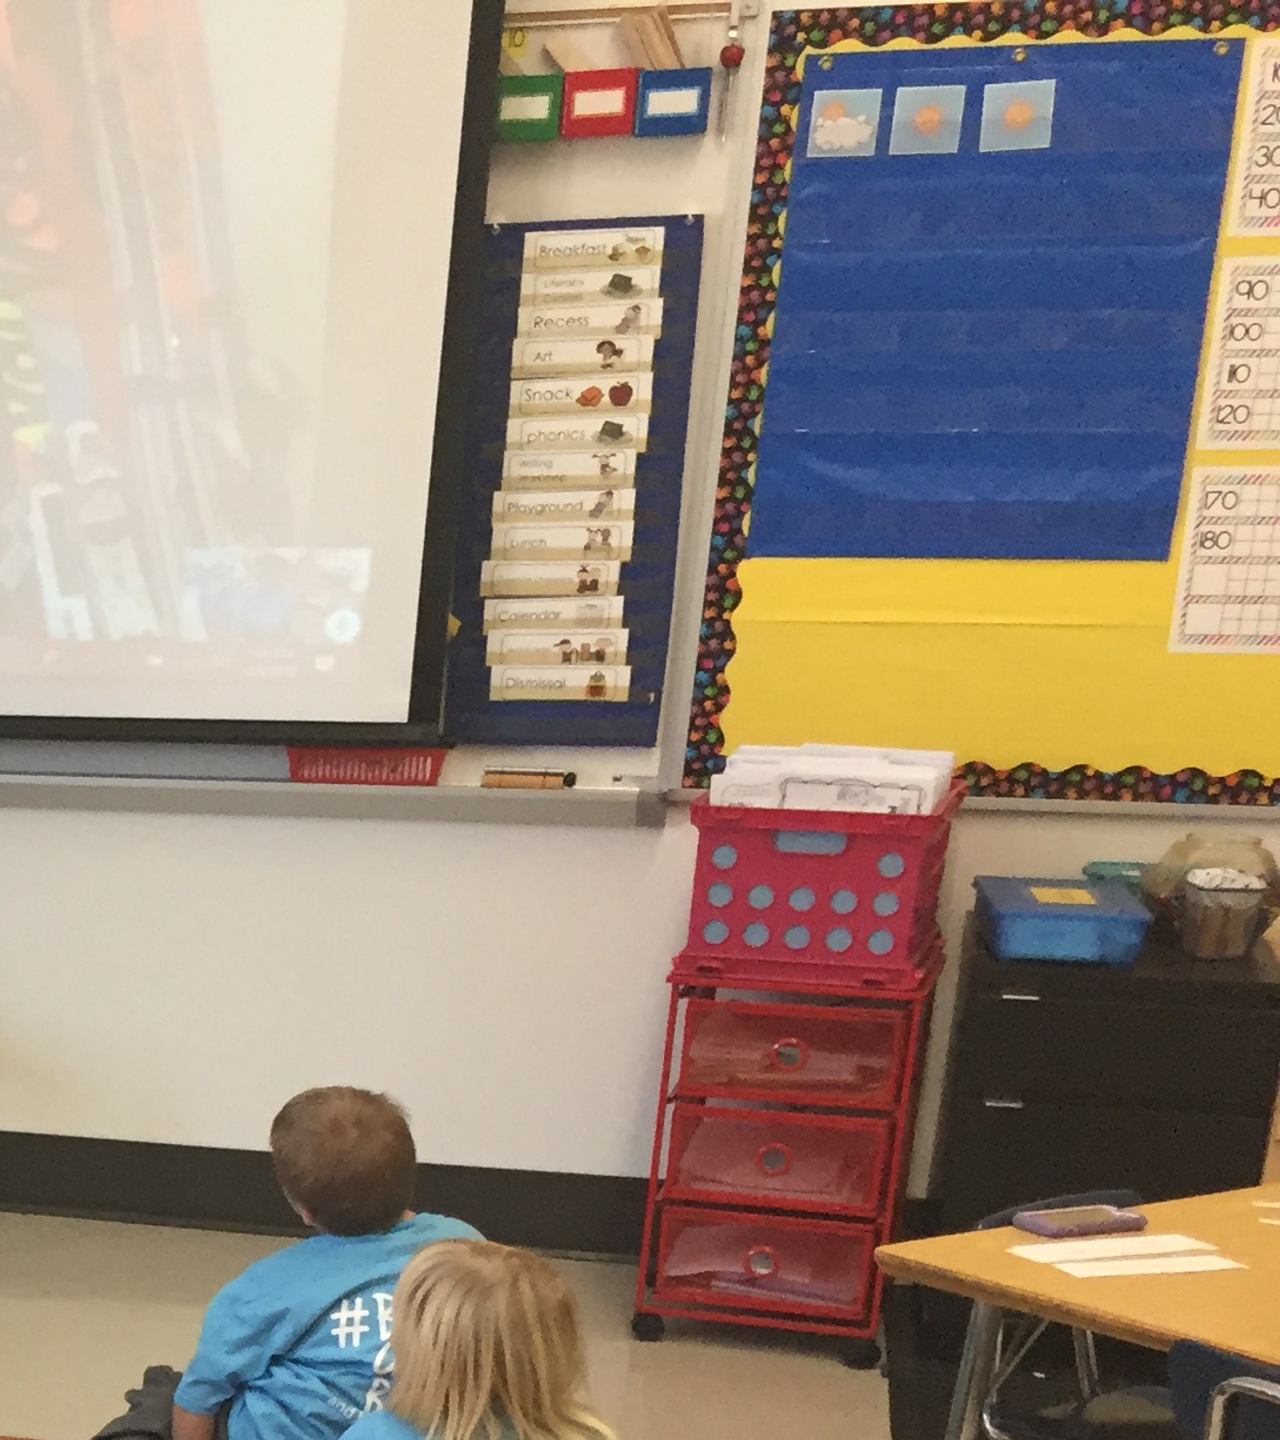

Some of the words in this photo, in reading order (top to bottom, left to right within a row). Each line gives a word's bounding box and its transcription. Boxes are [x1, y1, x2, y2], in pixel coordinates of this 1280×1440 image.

[508, 28, 526, 49] 10
[1249, 187, 1280, 210] 40
[539, 243, 607, 258] Breakfast
[1235, 279, 1270, 301] 90
[533, 315, 590, 329] Recess
[1228, 322, 1264, 342] 100
[533, 350, 553, 363] Art
[523, 387, 575, 402] Snack
[1216, 404, 1251, 425] 120
[526, 428, 587, 446] phonics
[507, 501, 585, 517] Playground
[1199, 530, 1233, 550] 180
[497, 608, 563, 623] Calendar
[504, 674, 568, 691] Dismissal
